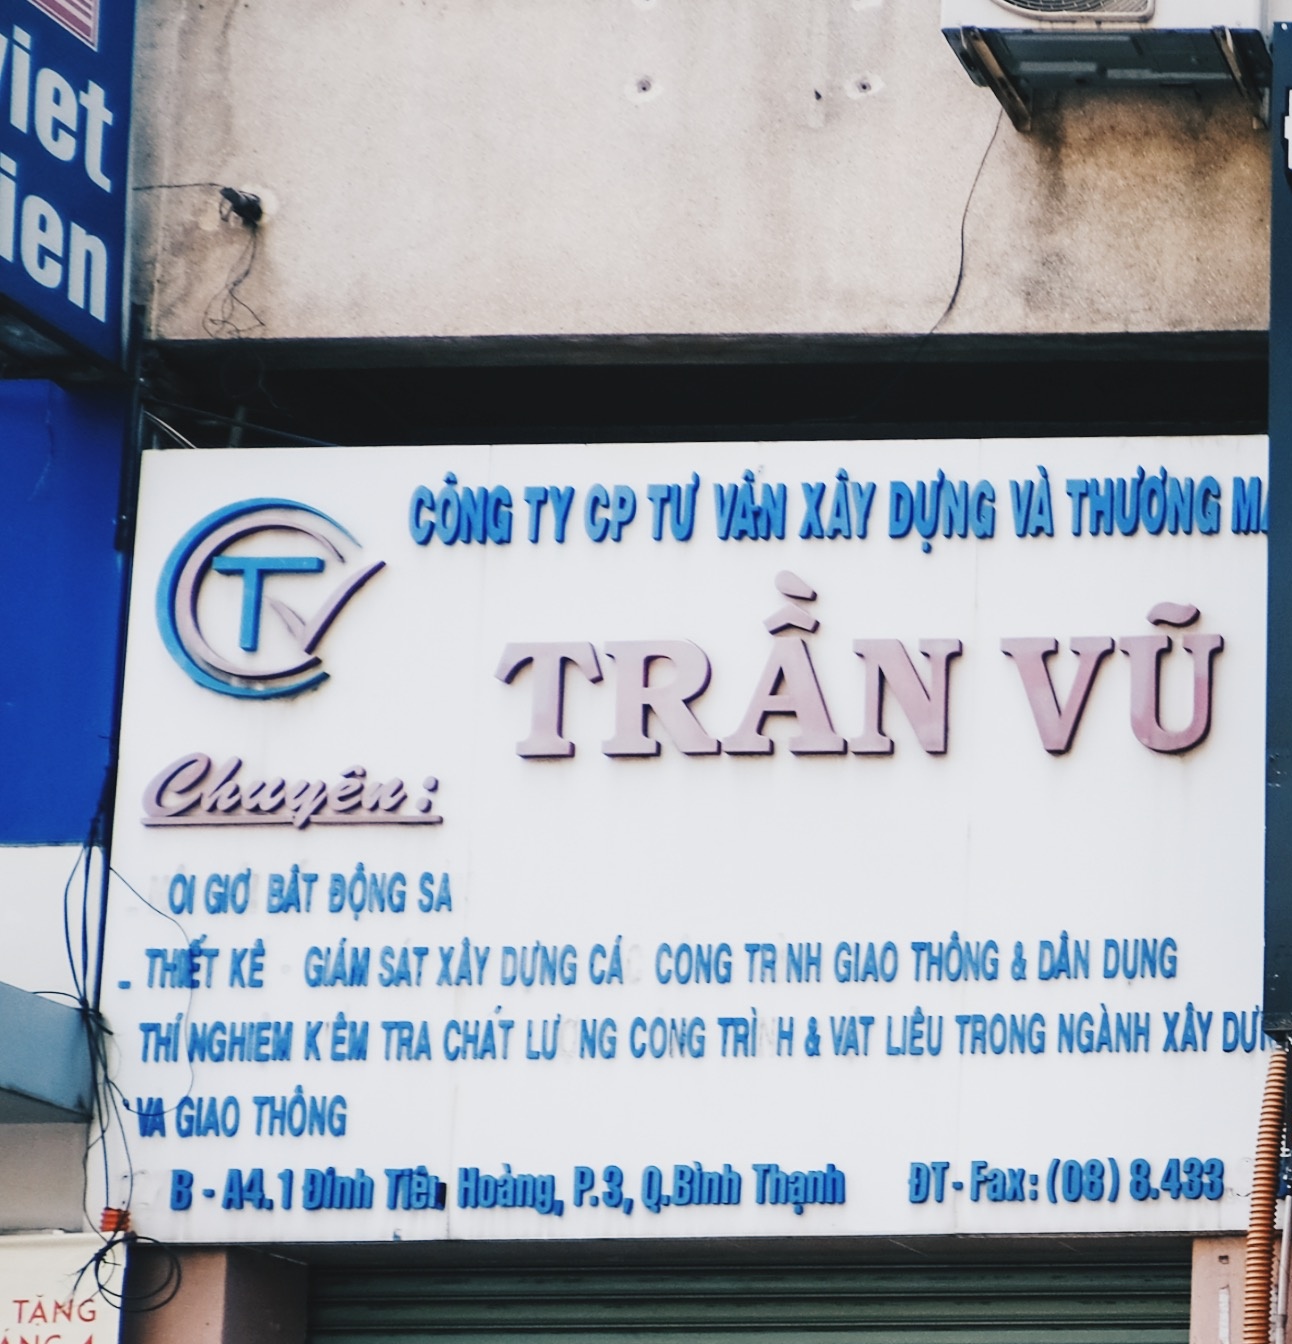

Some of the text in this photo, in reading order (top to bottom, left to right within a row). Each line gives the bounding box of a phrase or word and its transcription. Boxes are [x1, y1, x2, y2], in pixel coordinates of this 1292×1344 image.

[408, 471, 513, 546] CÔNG
[523, 485, 576, 544] TY
[583, 484, 637, 543] CP
[647, 471, 701, 542] TƯ
[799, 468, 877, 540] XÂY
[888, 467, 997, 554] DỰNG
[1008, 465, 1055, 538] VÀ
[1065, 465, 1222, 536] THƯƠNG
[495, 570, 1224, 757] TRẦN VŨ
[328, 862, 407, 921] ĐỘNG
[304, 937, 371, 988] GIÁM
[436, 936, 491, 987] XÂY
[833, 940, 899, 984] GIAO
[911, 930, 999, 982] THÔNG
[1010, 941, 1028, 981] &
[1038, 930, 1090, 981] DÂN
[381, 1020, 432, 1062] TRA
[804, 1016, 821, 1056] &
[955, 1013, 1046, 1055] TRONG
[1057, 1003, 1150, 1054] NGÀNH
[1162, 1002, 1213, 1053] XÂY
[175, 1085, 348, 1138] GIAO THÔNG
[170, 1169, 194, 1211] B
[752, 1163, 846, 1216] Thạnh
[13, 1294, 97, 1327] TẶNG
